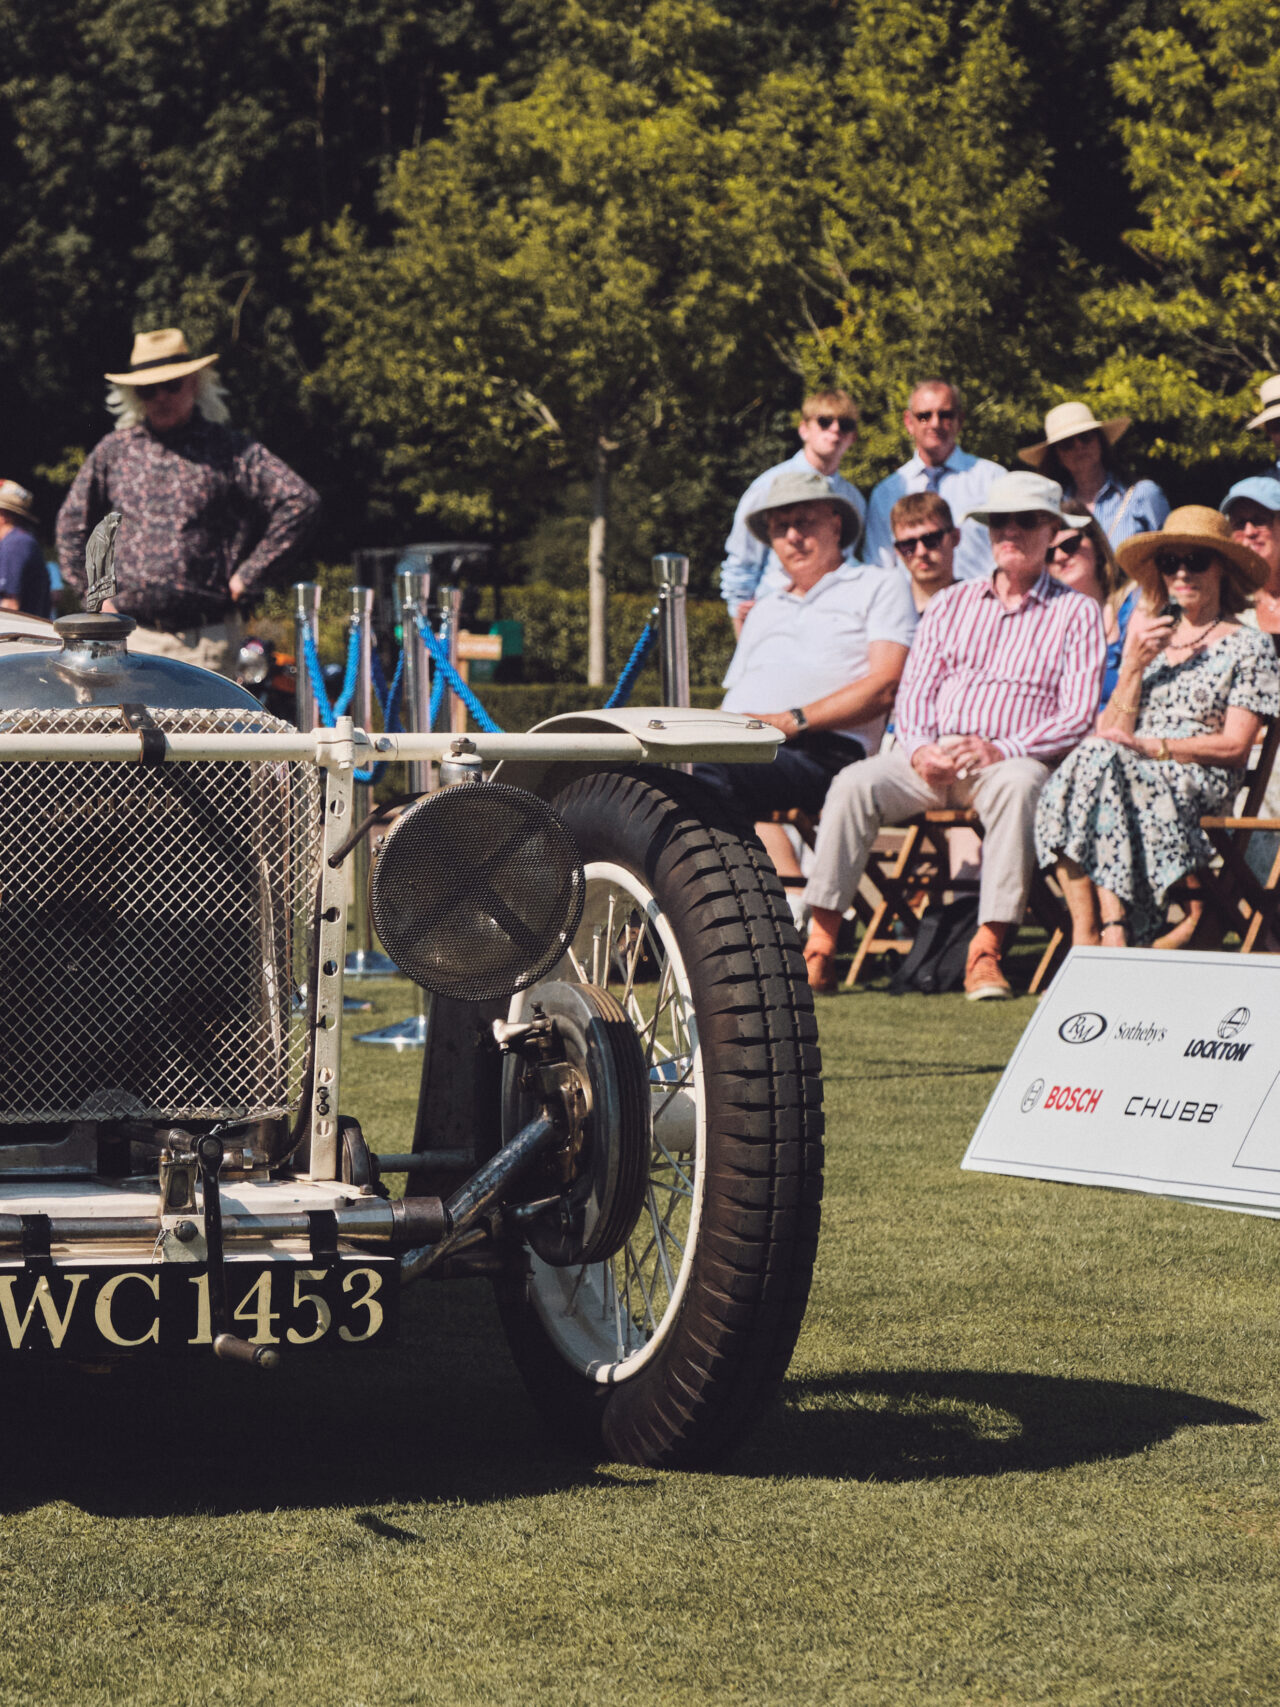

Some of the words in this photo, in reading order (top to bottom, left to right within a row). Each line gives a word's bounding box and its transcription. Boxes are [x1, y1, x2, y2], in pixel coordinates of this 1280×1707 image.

[1114, 1020, 1168, 1046] Sotheby's
[1183, 1039, 1251, 1062] LOCKTON
[1044, 1086, 1104, 1114] BOSCH
[1124, 1096, 1218, 1124] CHUBB
[188, 1267, 385, 1345] 1453
